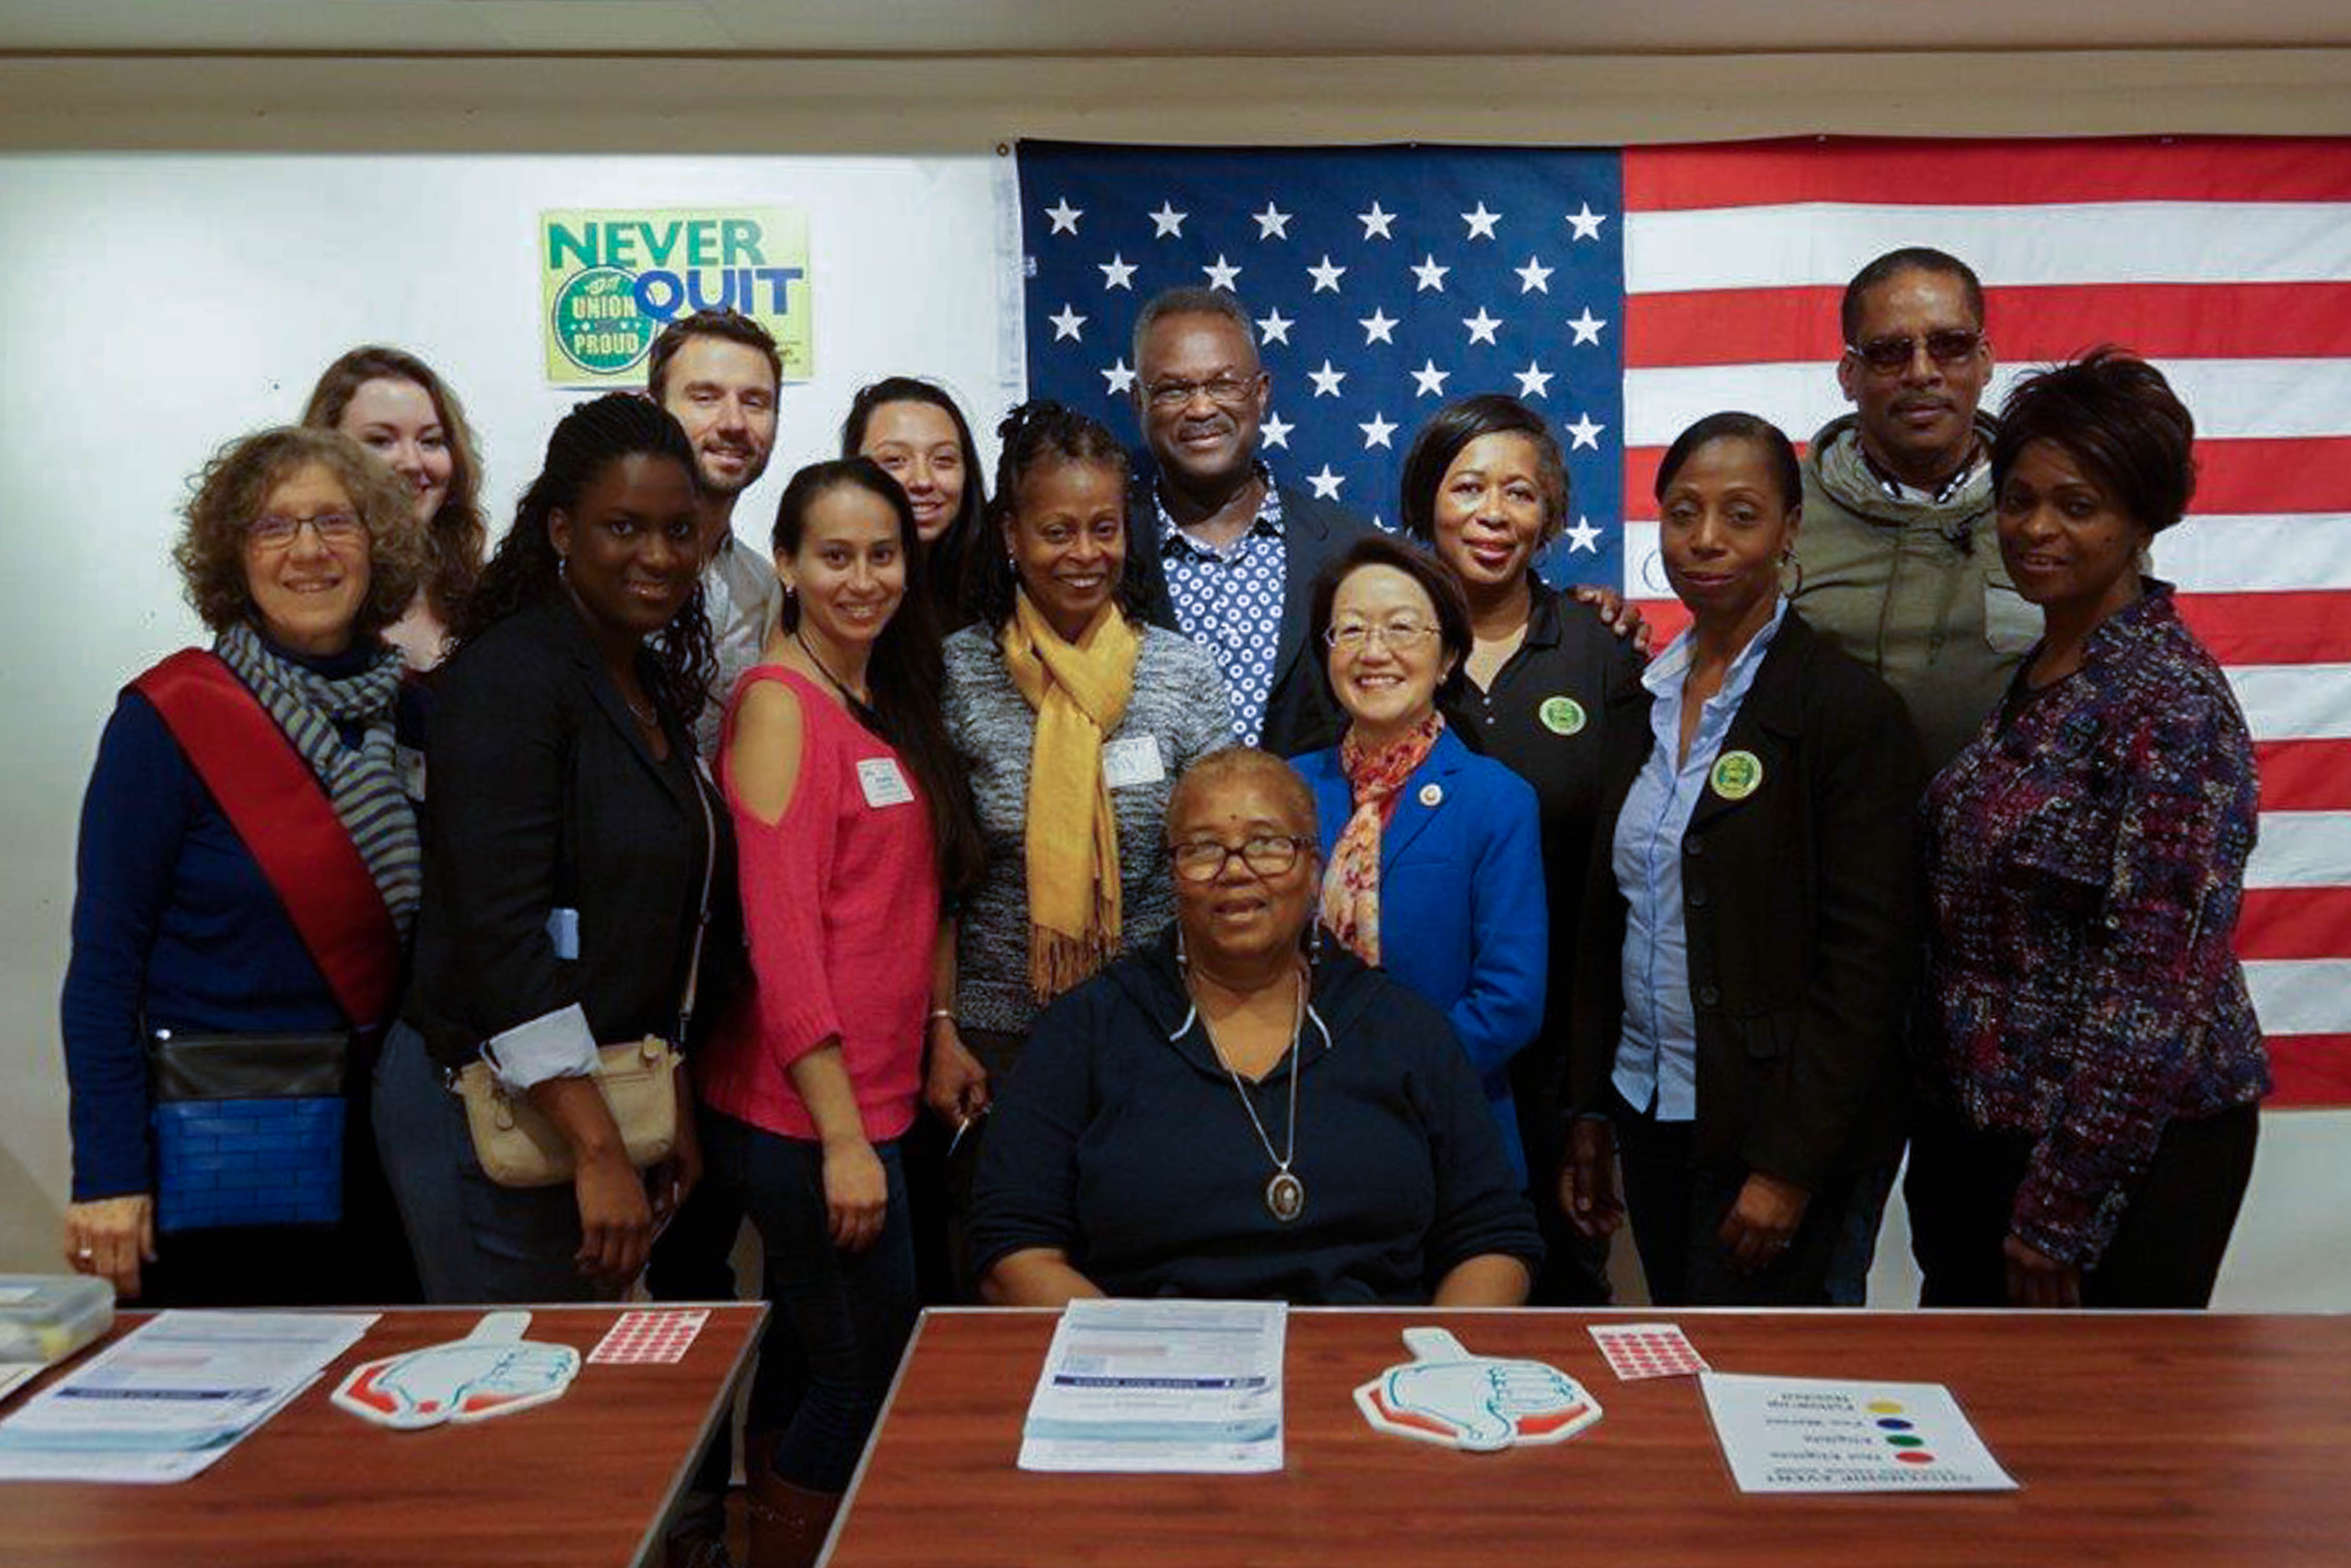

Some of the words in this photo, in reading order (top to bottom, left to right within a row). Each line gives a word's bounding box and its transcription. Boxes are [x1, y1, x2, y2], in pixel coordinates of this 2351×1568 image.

[548, 219, 767, 269] NEVER
[572, 295, 638, 320] UNION
[634, 268, 803, 324] QUIT
[573, 332, 639, 356] PROUD
